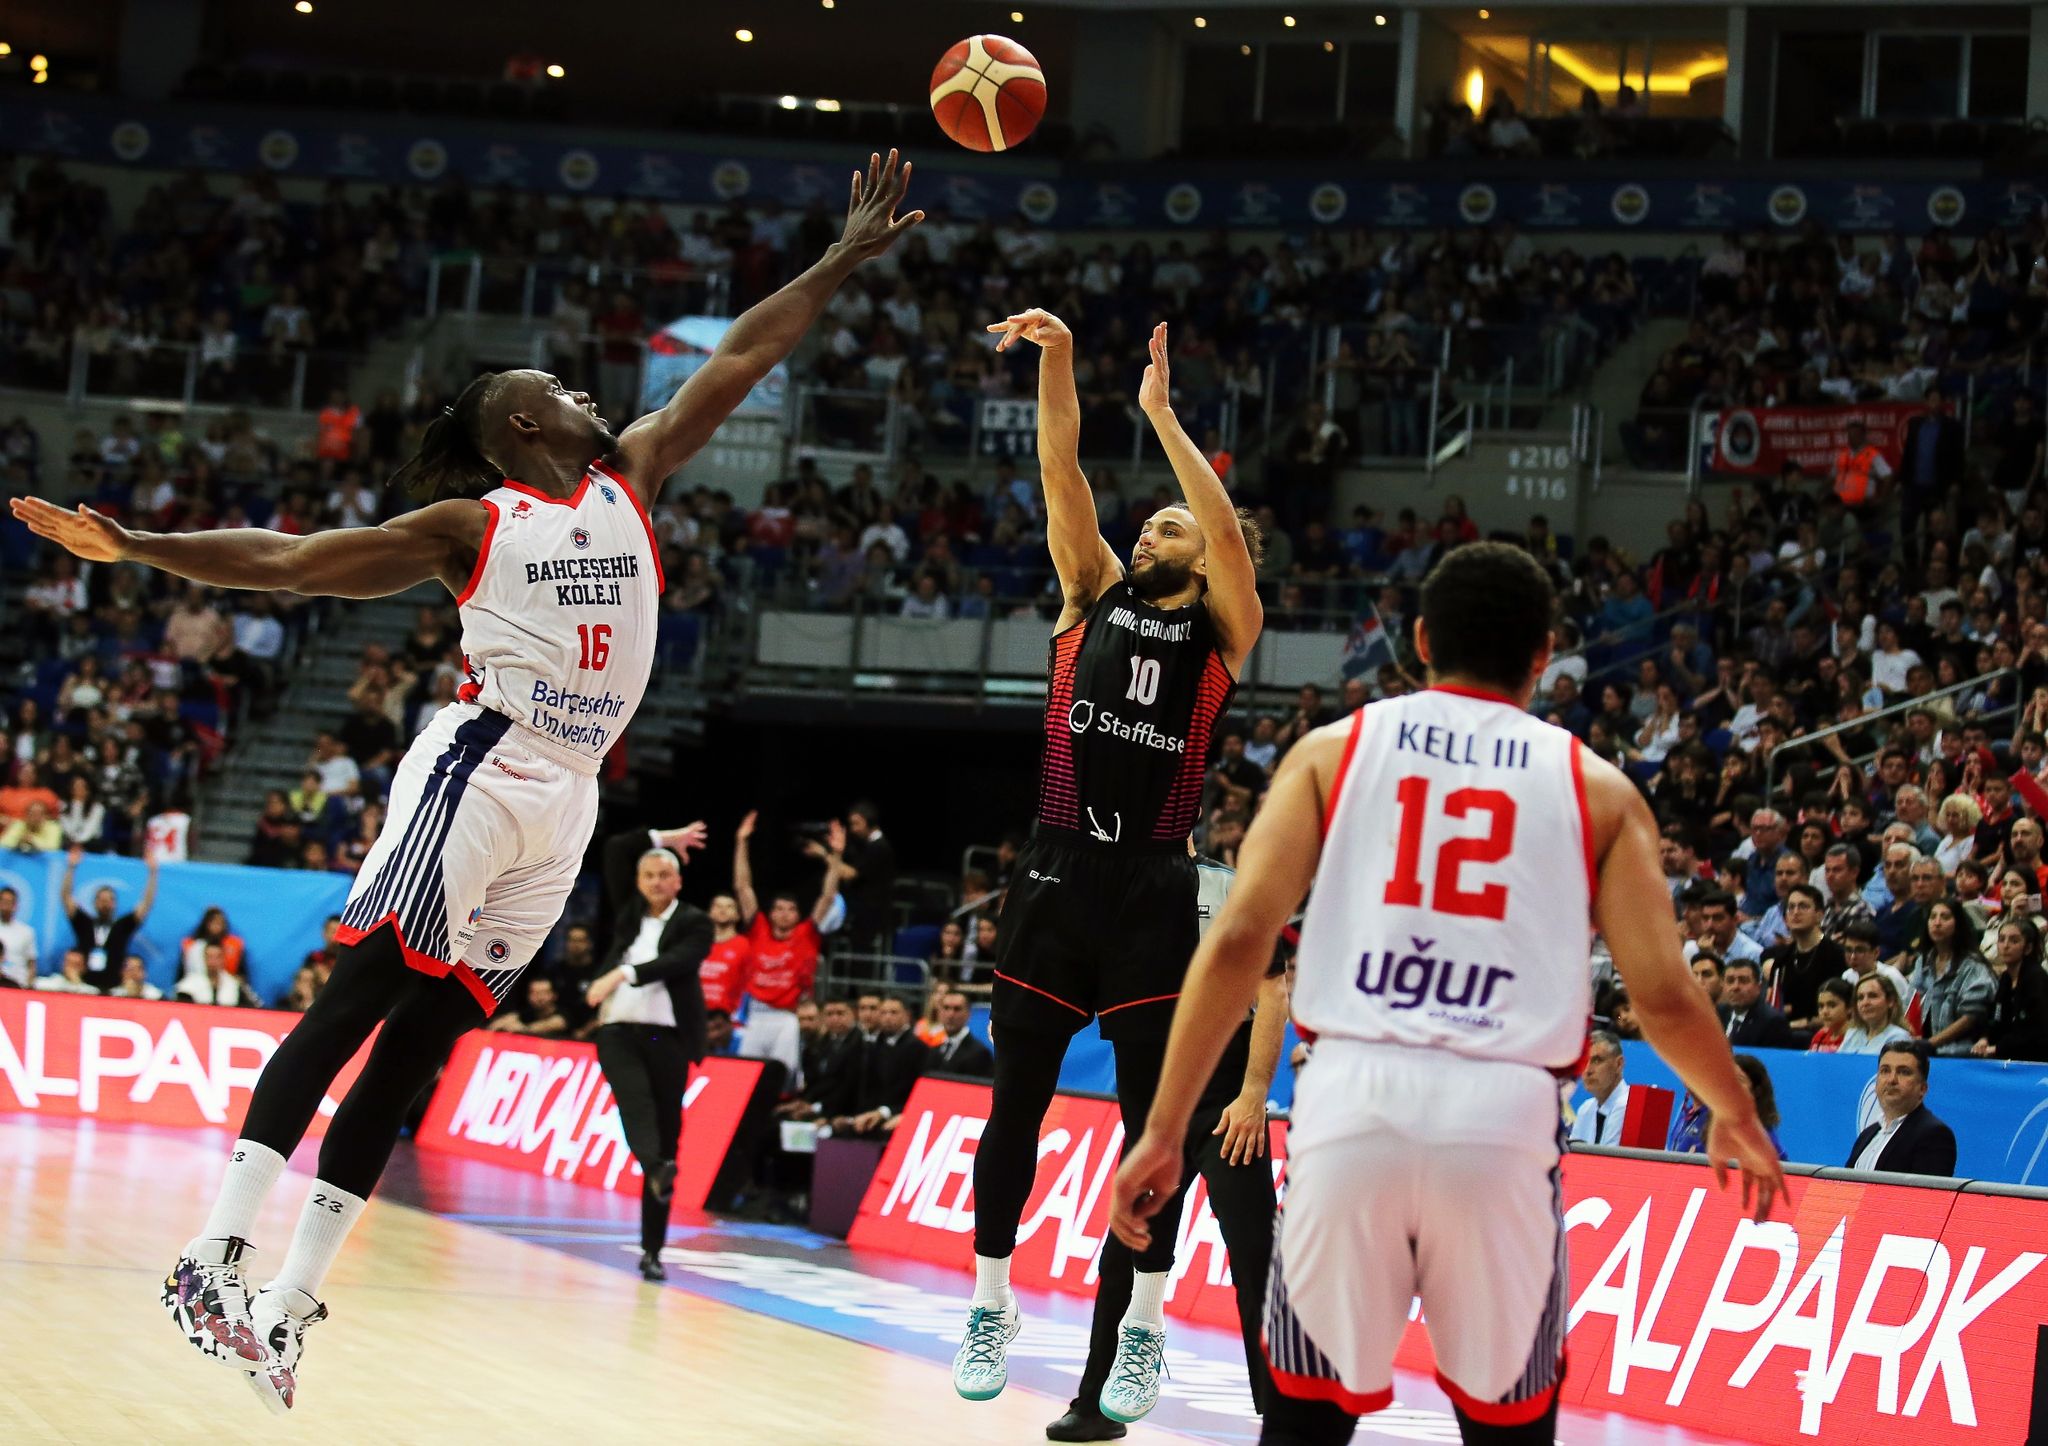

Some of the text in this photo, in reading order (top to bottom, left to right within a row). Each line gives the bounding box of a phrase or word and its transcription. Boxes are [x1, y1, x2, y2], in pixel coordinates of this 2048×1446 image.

[525, 553, 639, 585] BAHÇEŞEHİR
[556, 581, 622, 606] KOLEJİ
[577, 624, 612, 671] 16
[531, 679, 625, 718] Bahçeşehir
[1125, 655, 1161, 705] 10
[1097, 711, 1185, 754] Staffbase
[1398, 721, 1530, 769] KELL III
[1383, 775, 1518, 922] 12
[1356, 935, 1515, 1009] uğur
[0, 1000, 294, 1123] LPAR
[313, 1193, 344, 1214] 23
